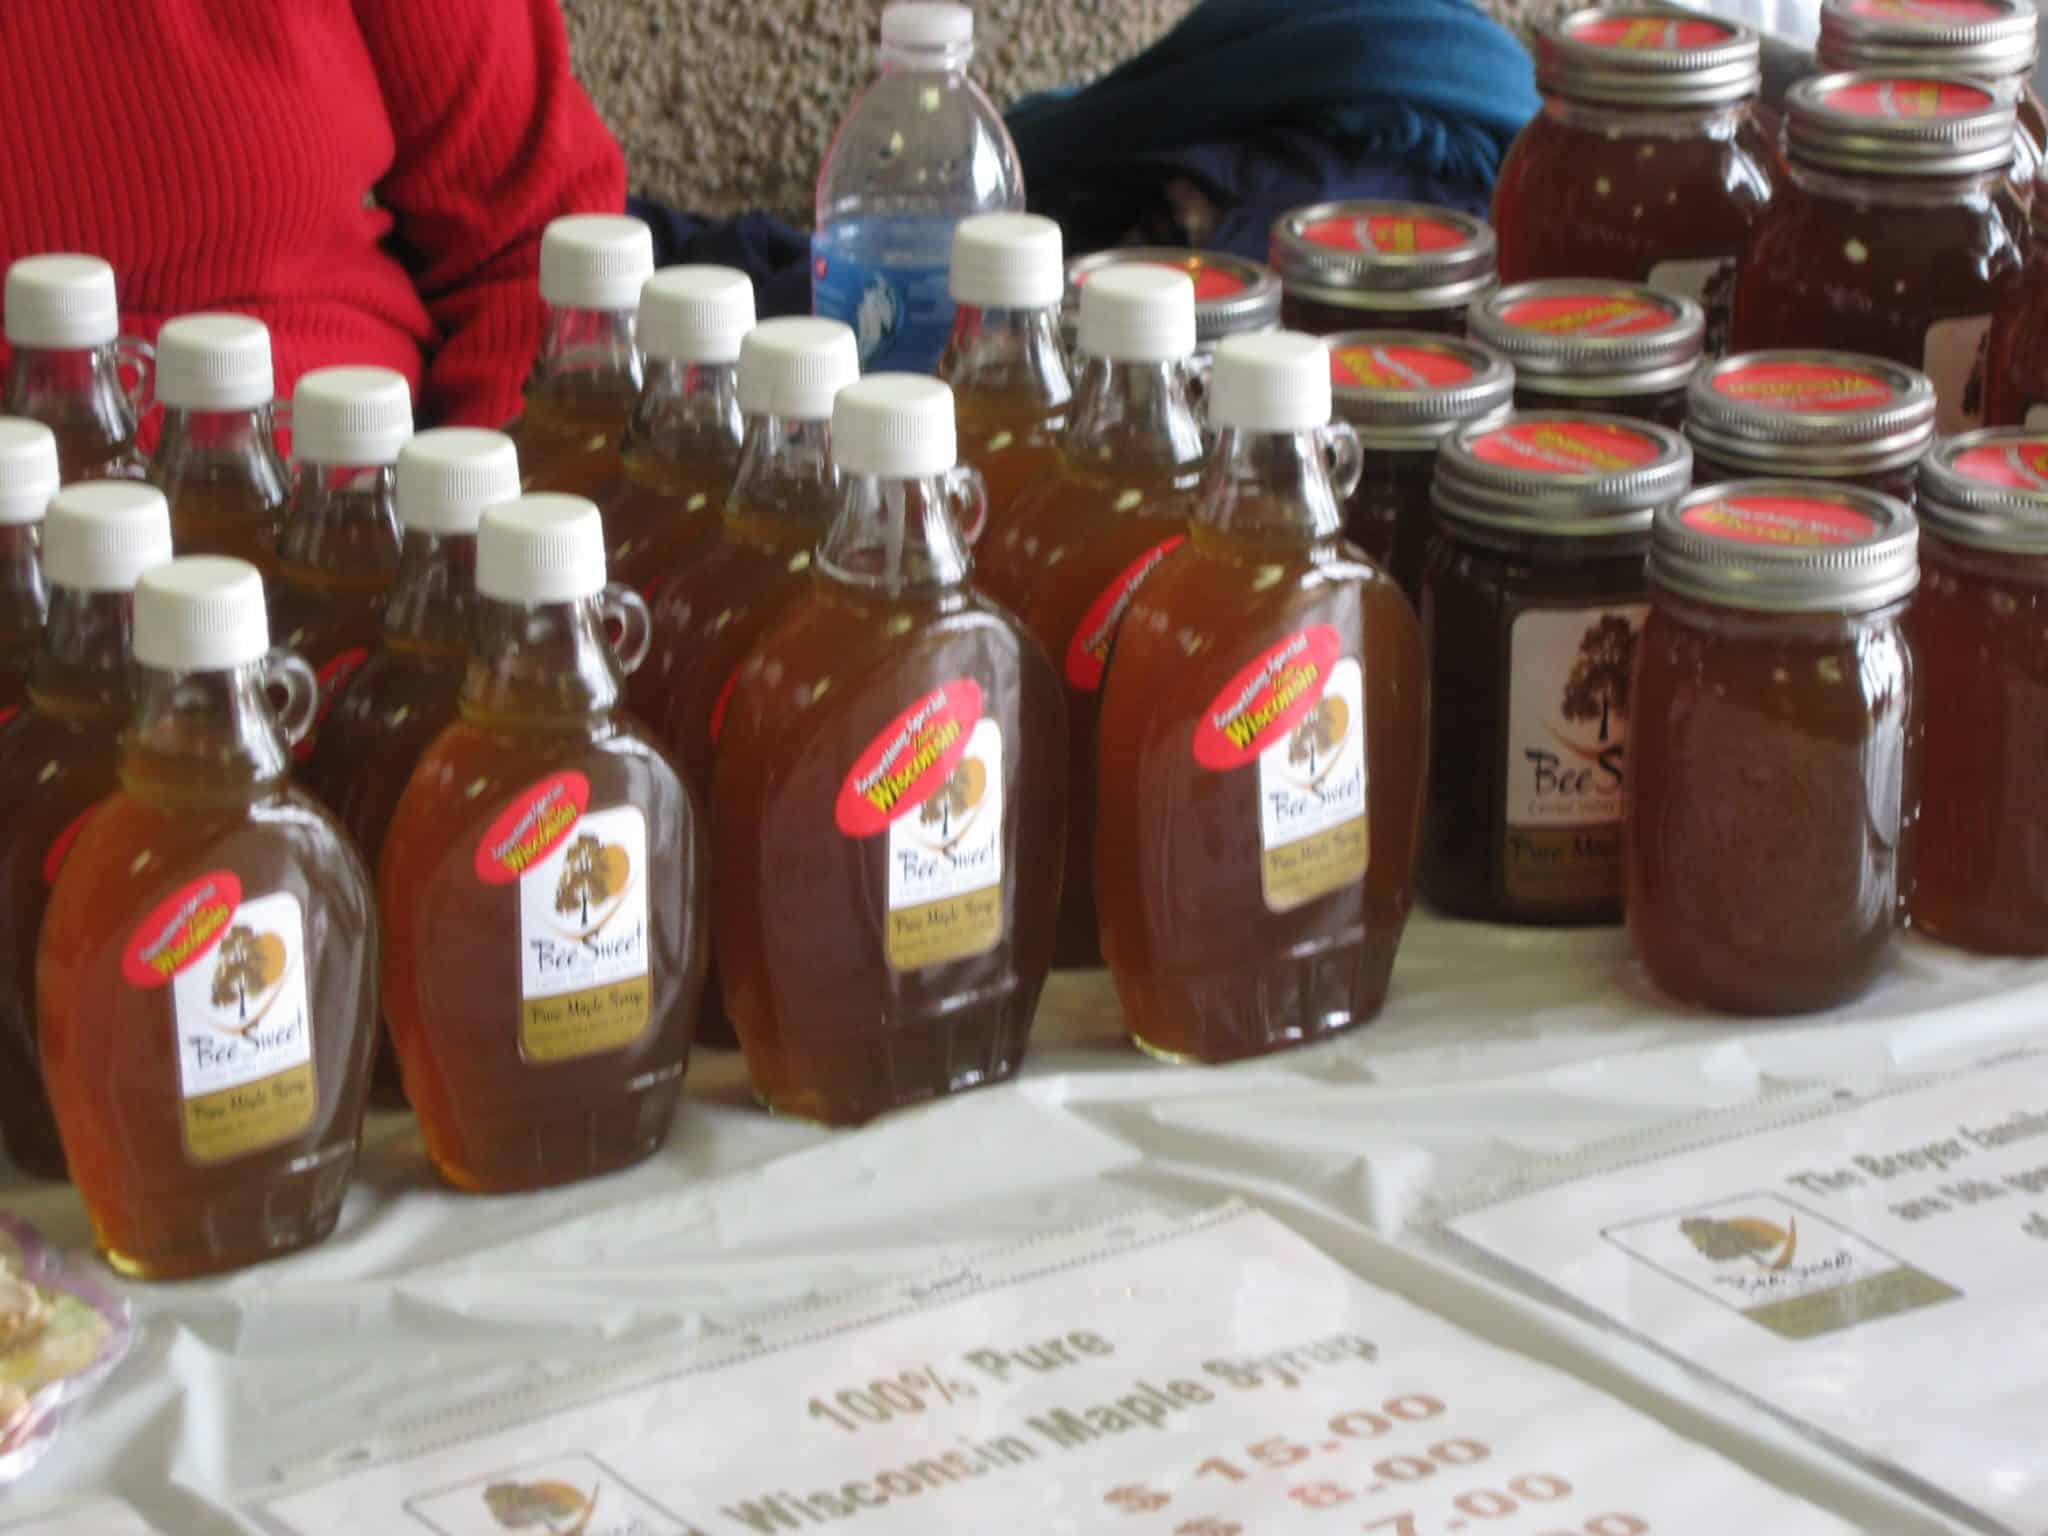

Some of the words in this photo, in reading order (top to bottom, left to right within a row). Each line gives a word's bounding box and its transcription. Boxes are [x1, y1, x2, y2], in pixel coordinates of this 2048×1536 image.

[1225, 660, 1321, 751] Wisconsin
[866, 717, 962, 816] Wisconsin
[808, 1363, 979, 1433] 100%
[962, 1330, 1116, 1384] Pure
[718, 1435, 1040, 1535] Wisconsin
[1024, 1379, 1217, 1449] Maple
[1200, 1332, 1379, 1390] Syrup
